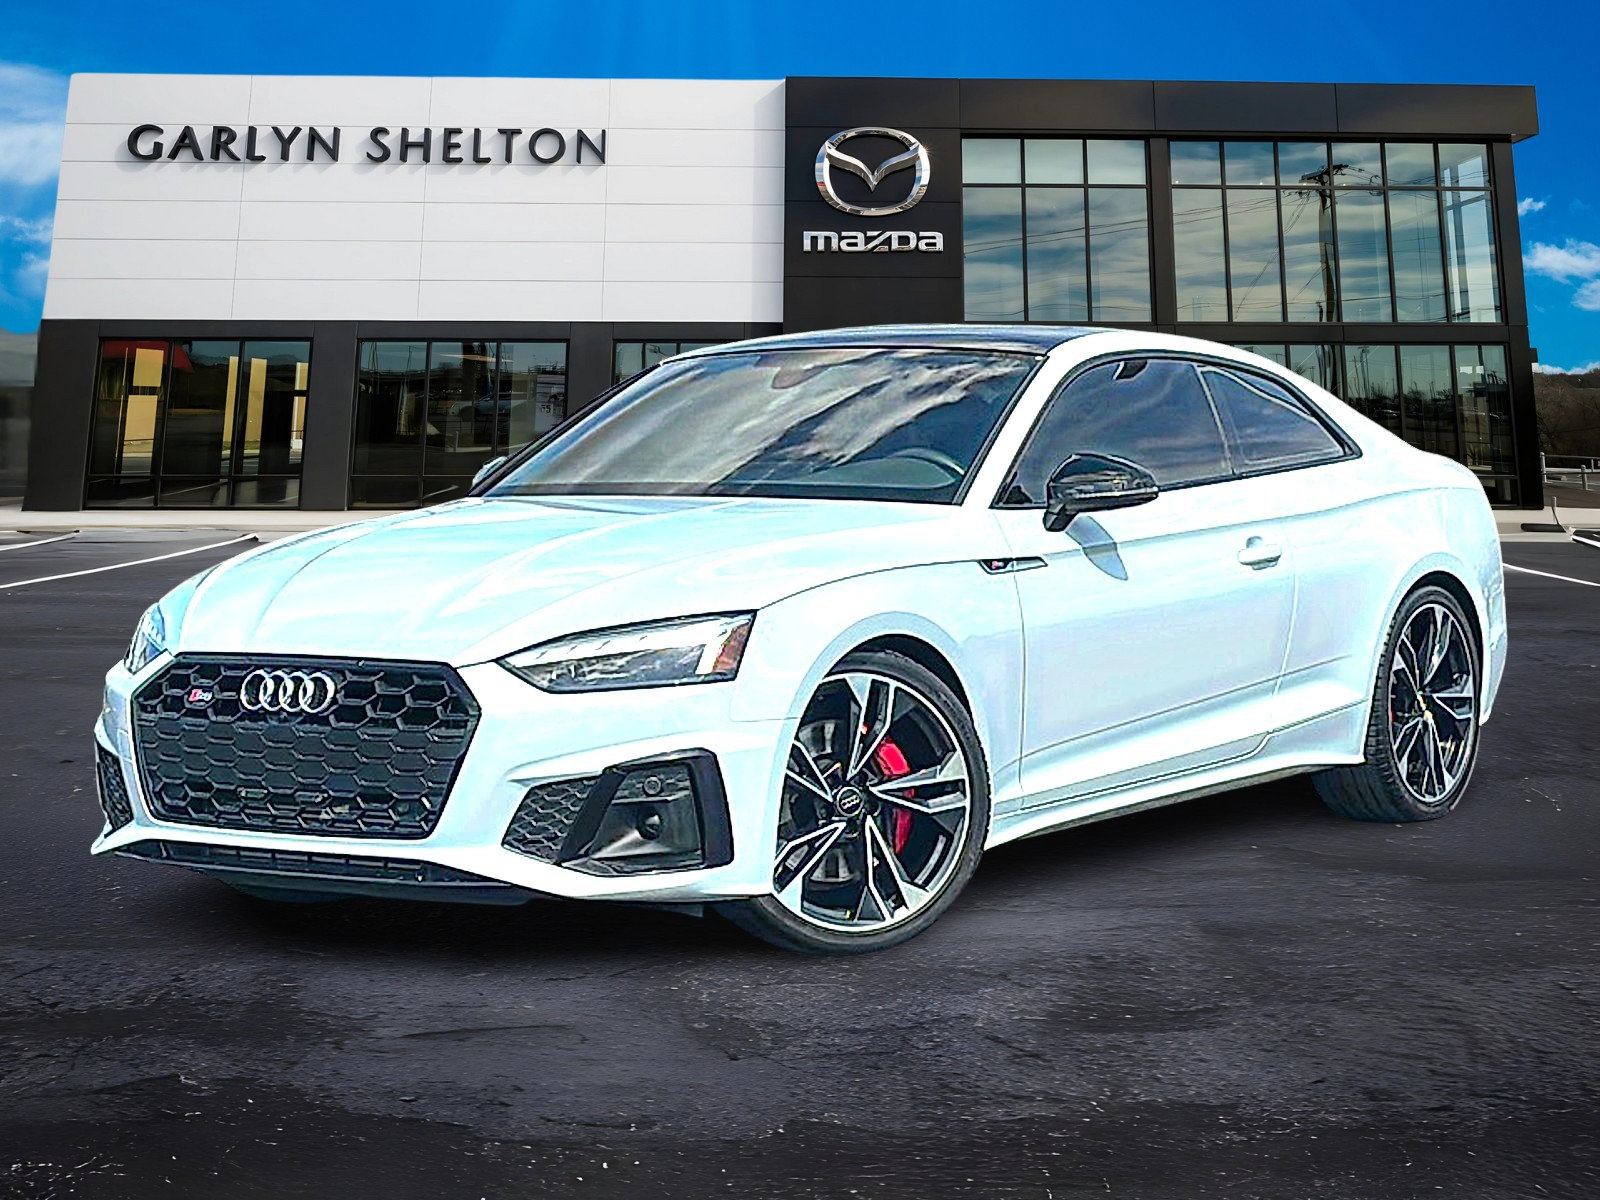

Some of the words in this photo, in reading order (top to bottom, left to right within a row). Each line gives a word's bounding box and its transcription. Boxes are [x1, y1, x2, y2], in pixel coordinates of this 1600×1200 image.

[127, 124, 341, 161] GARLYN
[366, 127, 606, 164] SHELTON
[803, 231, 944, 252] mazda
